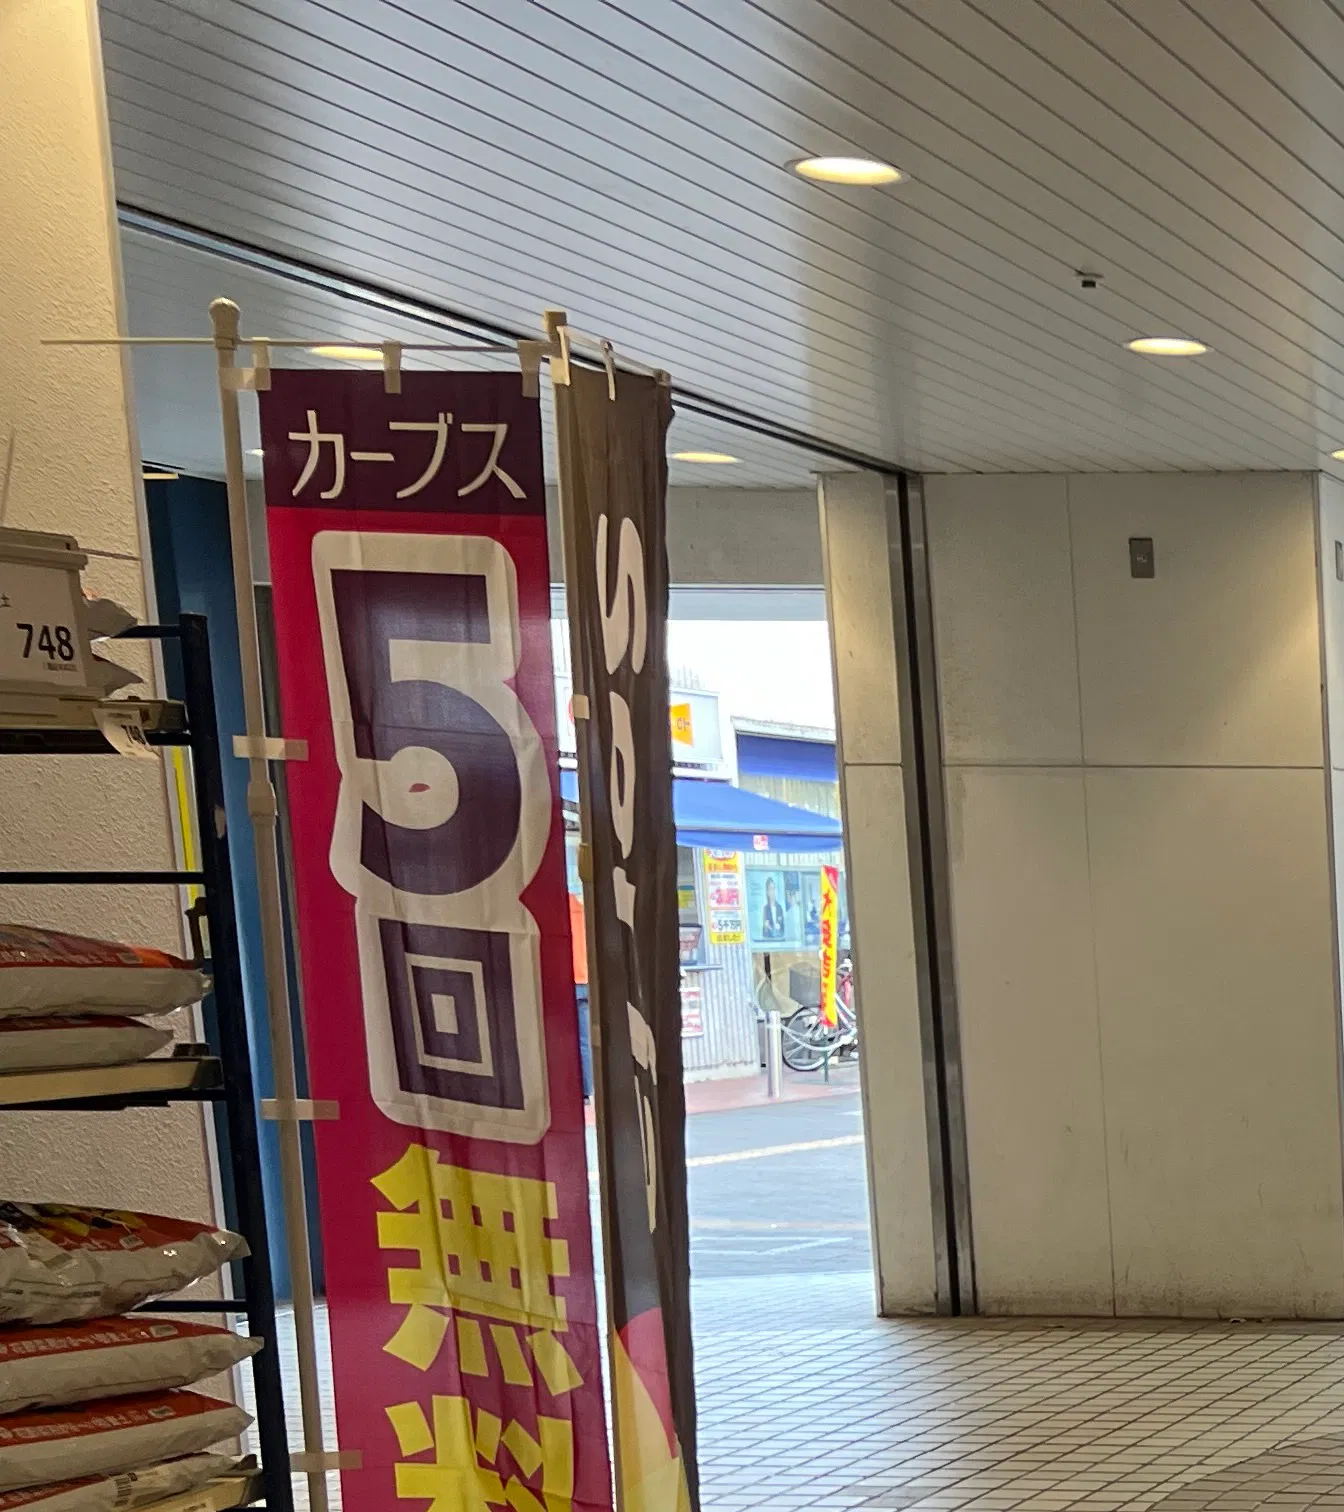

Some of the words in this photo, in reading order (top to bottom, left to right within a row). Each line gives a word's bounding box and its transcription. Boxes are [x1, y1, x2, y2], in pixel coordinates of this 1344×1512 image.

[288, 410, 527, 500] カーブス
[16, 623, 74, 661] 748
